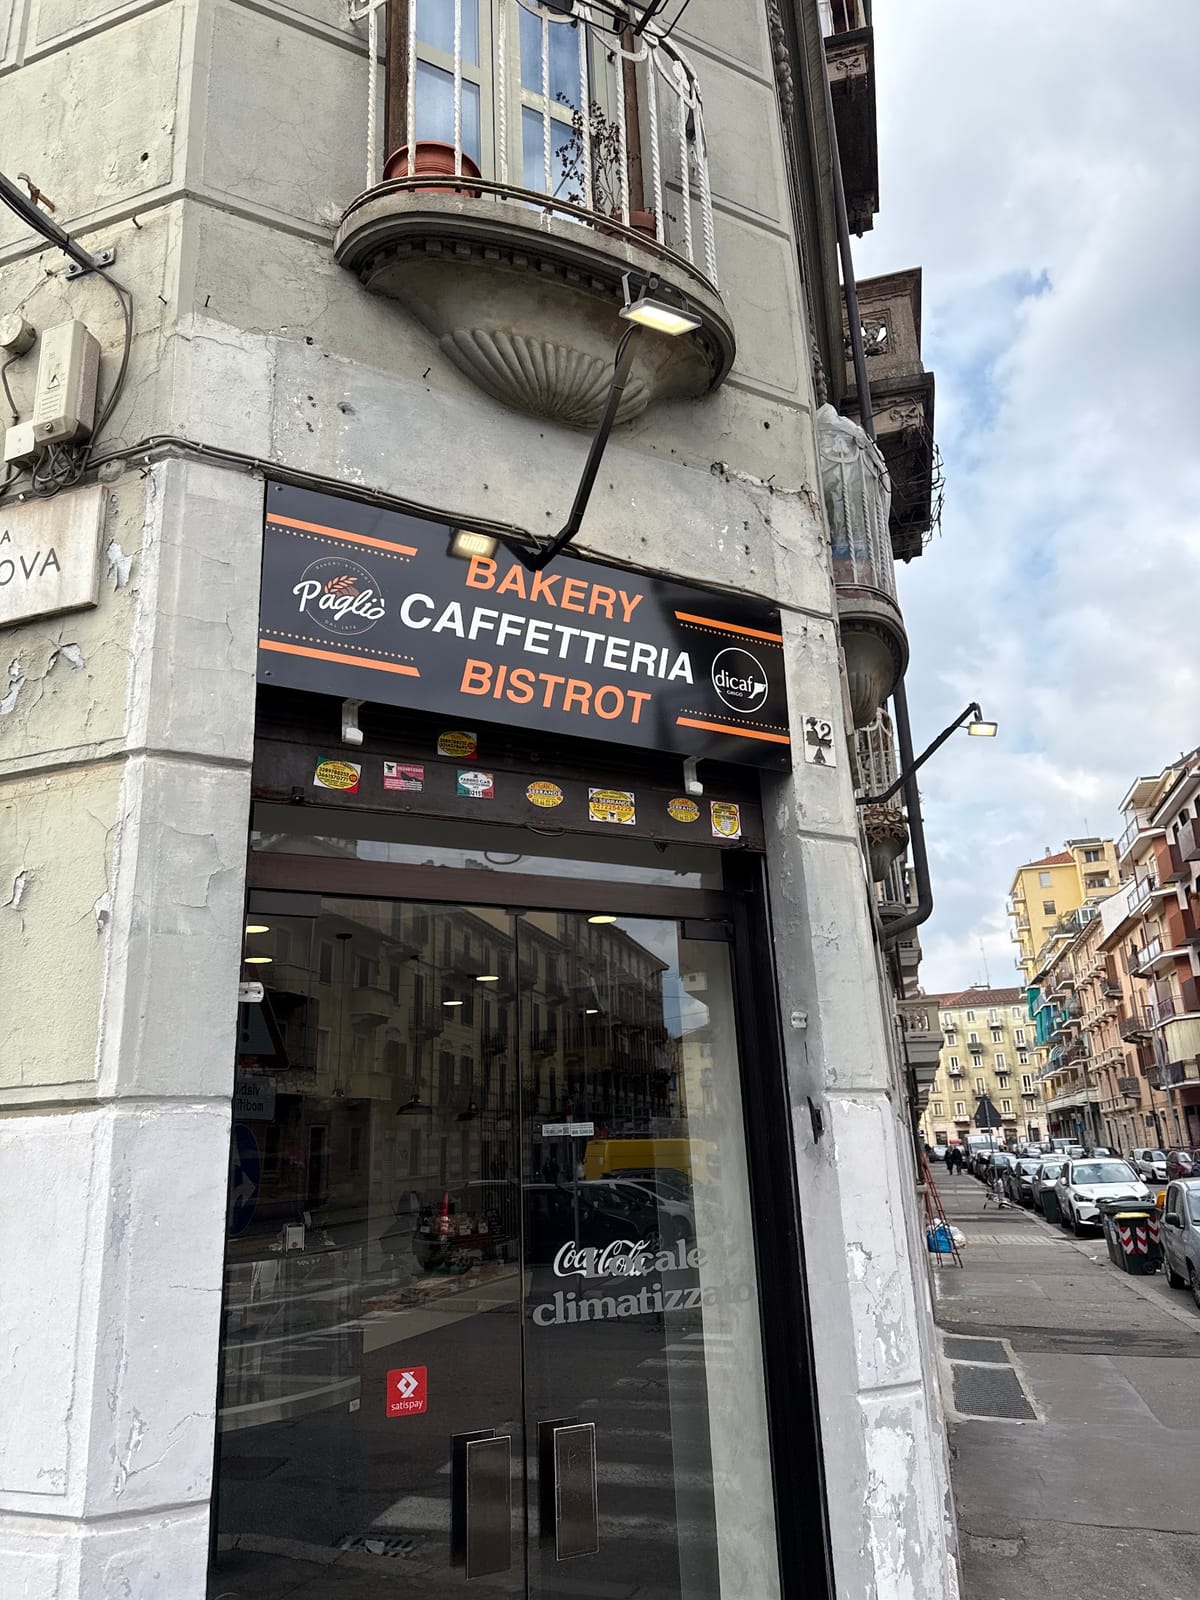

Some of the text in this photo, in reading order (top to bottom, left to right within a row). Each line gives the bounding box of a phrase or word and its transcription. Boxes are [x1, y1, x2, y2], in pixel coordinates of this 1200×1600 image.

[292, 580, 386, 620] Pagliò
[465, 554, 644, 624] BAKERY
[400, 593, 695, 685] CAFFETTERIA
[460, 658, 652, 724] BISTROT
[584, 1238, 709, 1279] Locale
[391, 1399, 424, 1411] satispay
